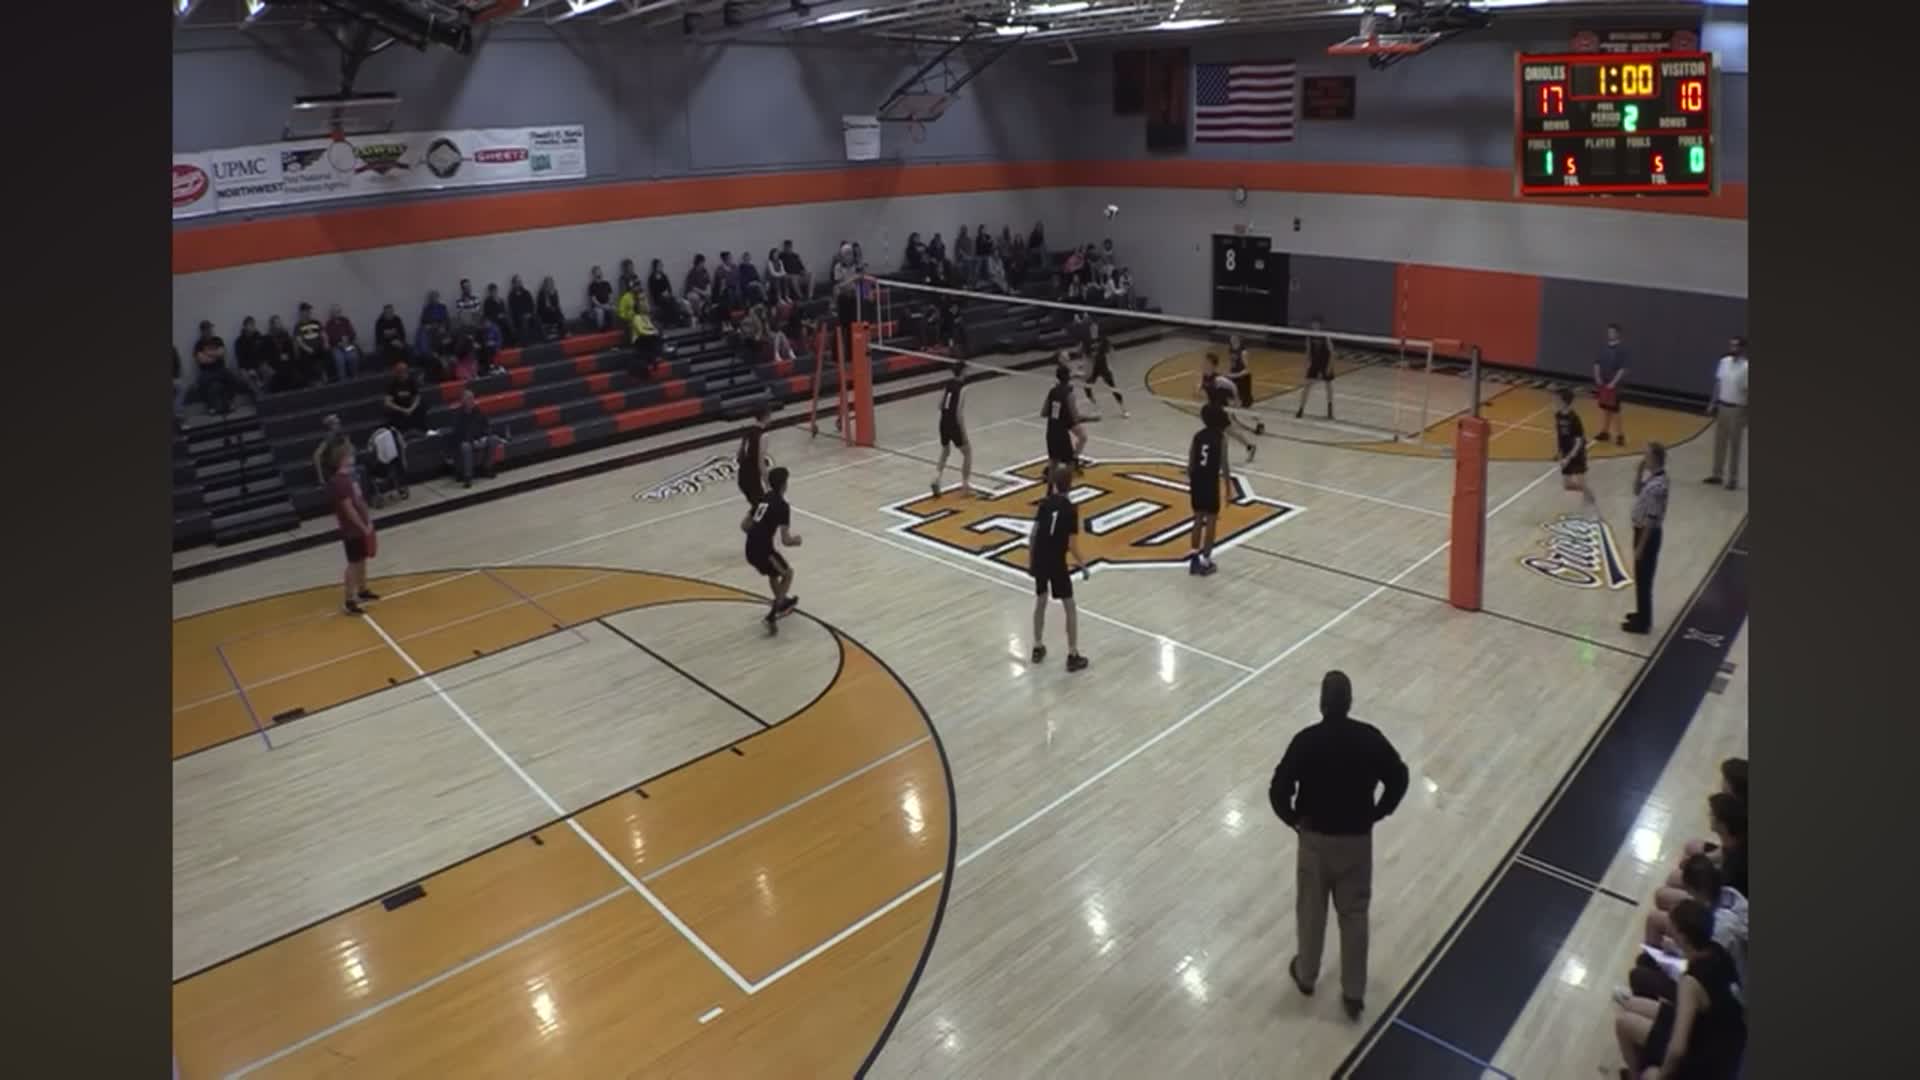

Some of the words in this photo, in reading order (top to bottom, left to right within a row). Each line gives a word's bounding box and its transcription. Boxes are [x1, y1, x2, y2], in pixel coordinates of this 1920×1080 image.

[1525, 65, 1566, 81] ORIOLES
[1662, 61, 1705, 76] VISITOR
[1599, 64, 1653, 95] 1:00
[1542, 86, 1563, 113] 17
[1681, 82, 1702, 110] 10
[1591, 112, 1620, 122] PERIOD
[1623, 104, 1638, 132] 2
[1659, 117, 1687, 128] BONUS
[1528, 138, 1552, 150] FOULS
[1585, 138, 1616, 149] PLAYER
[1626, 136, 1651, 148] FOULS
[1678, 136, 1703, 147] FOULS
[479, 151, 526, 161] SHEETZ
[1546, 150, 1554, 175] 1
[1655, 155, 1665, 173] 5
[1690, 146, 1705, 173] 0
[213, 157, 267, 179] UPMC
[1566, 157, 1577, 175] 5
[216, 182, 285, 198] NORTHWEST
[1225, 248, 1237, 271] 8
[1200, 443, 1209, 466] 5
[1049, 511, 1059, 536] 1
